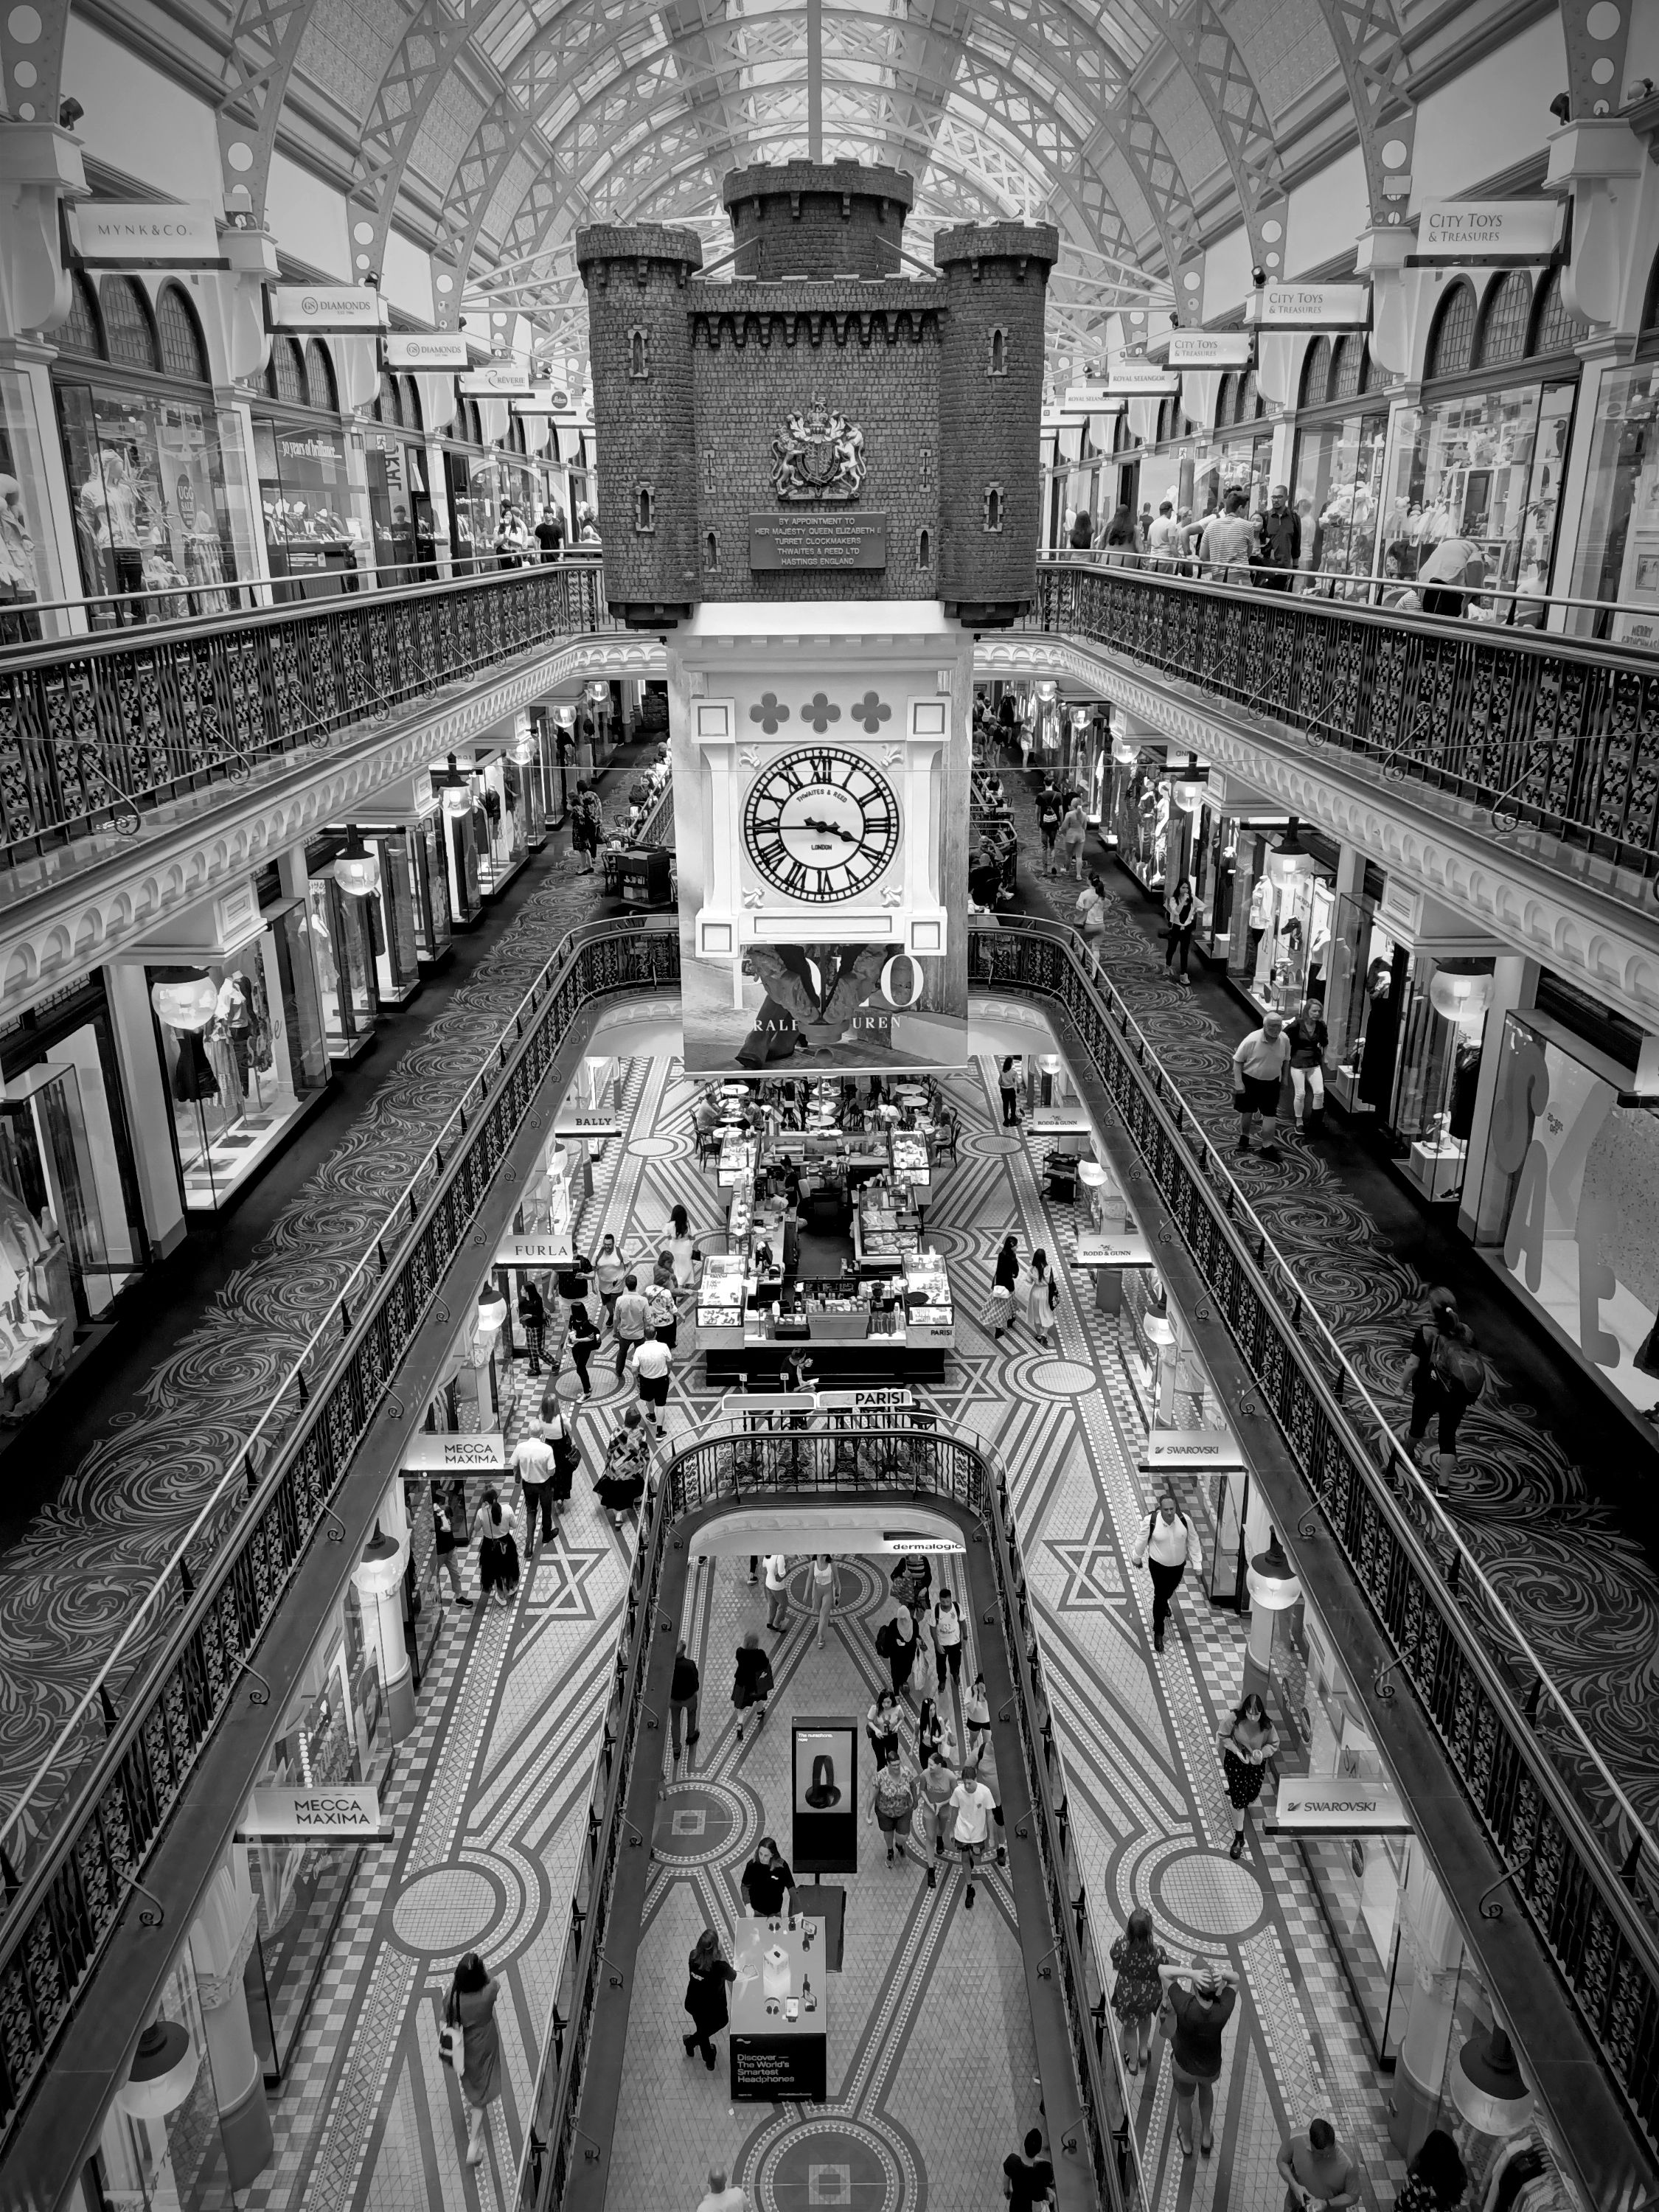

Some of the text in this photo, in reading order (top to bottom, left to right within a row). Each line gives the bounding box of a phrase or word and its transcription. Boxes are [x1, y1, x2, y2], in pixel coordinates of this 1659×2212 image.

[1430, 213, 1503, 228] CITY TOYS
[98, 225, 192, 235] MYNK&CO.
[1429, 232, 1500, 242] & TREASURES
[1269, 293, 1324, 303] CITY TOYS
[320, 302, 371, 310] DIAMONDS
[1279, 305, 1321, 313] TREASURES
[1175, 340, 1218, 349] CITY TOYS
[497, 376, 525, 384] RÊVERIE
[178, 486, 194, 500] UGG
[796, 789, 824, 802] THWAITES
[833, 791, 847, 803] REED
[853, 1017, 900, 1029] UREN
[515, 1245, 568, 1256] FURLA
[856, 1392, 904, 1405] PARISI
[444, 1444, 493, 1453] MECCA
[445, 1455, 498, 1464] MAXIMA
[294, 1800, 362, 1811] MECCA
[1304, 1802, 1376, 1811] SWAROVSKI
[296, 1813, 370, 1824] MAXIMA
